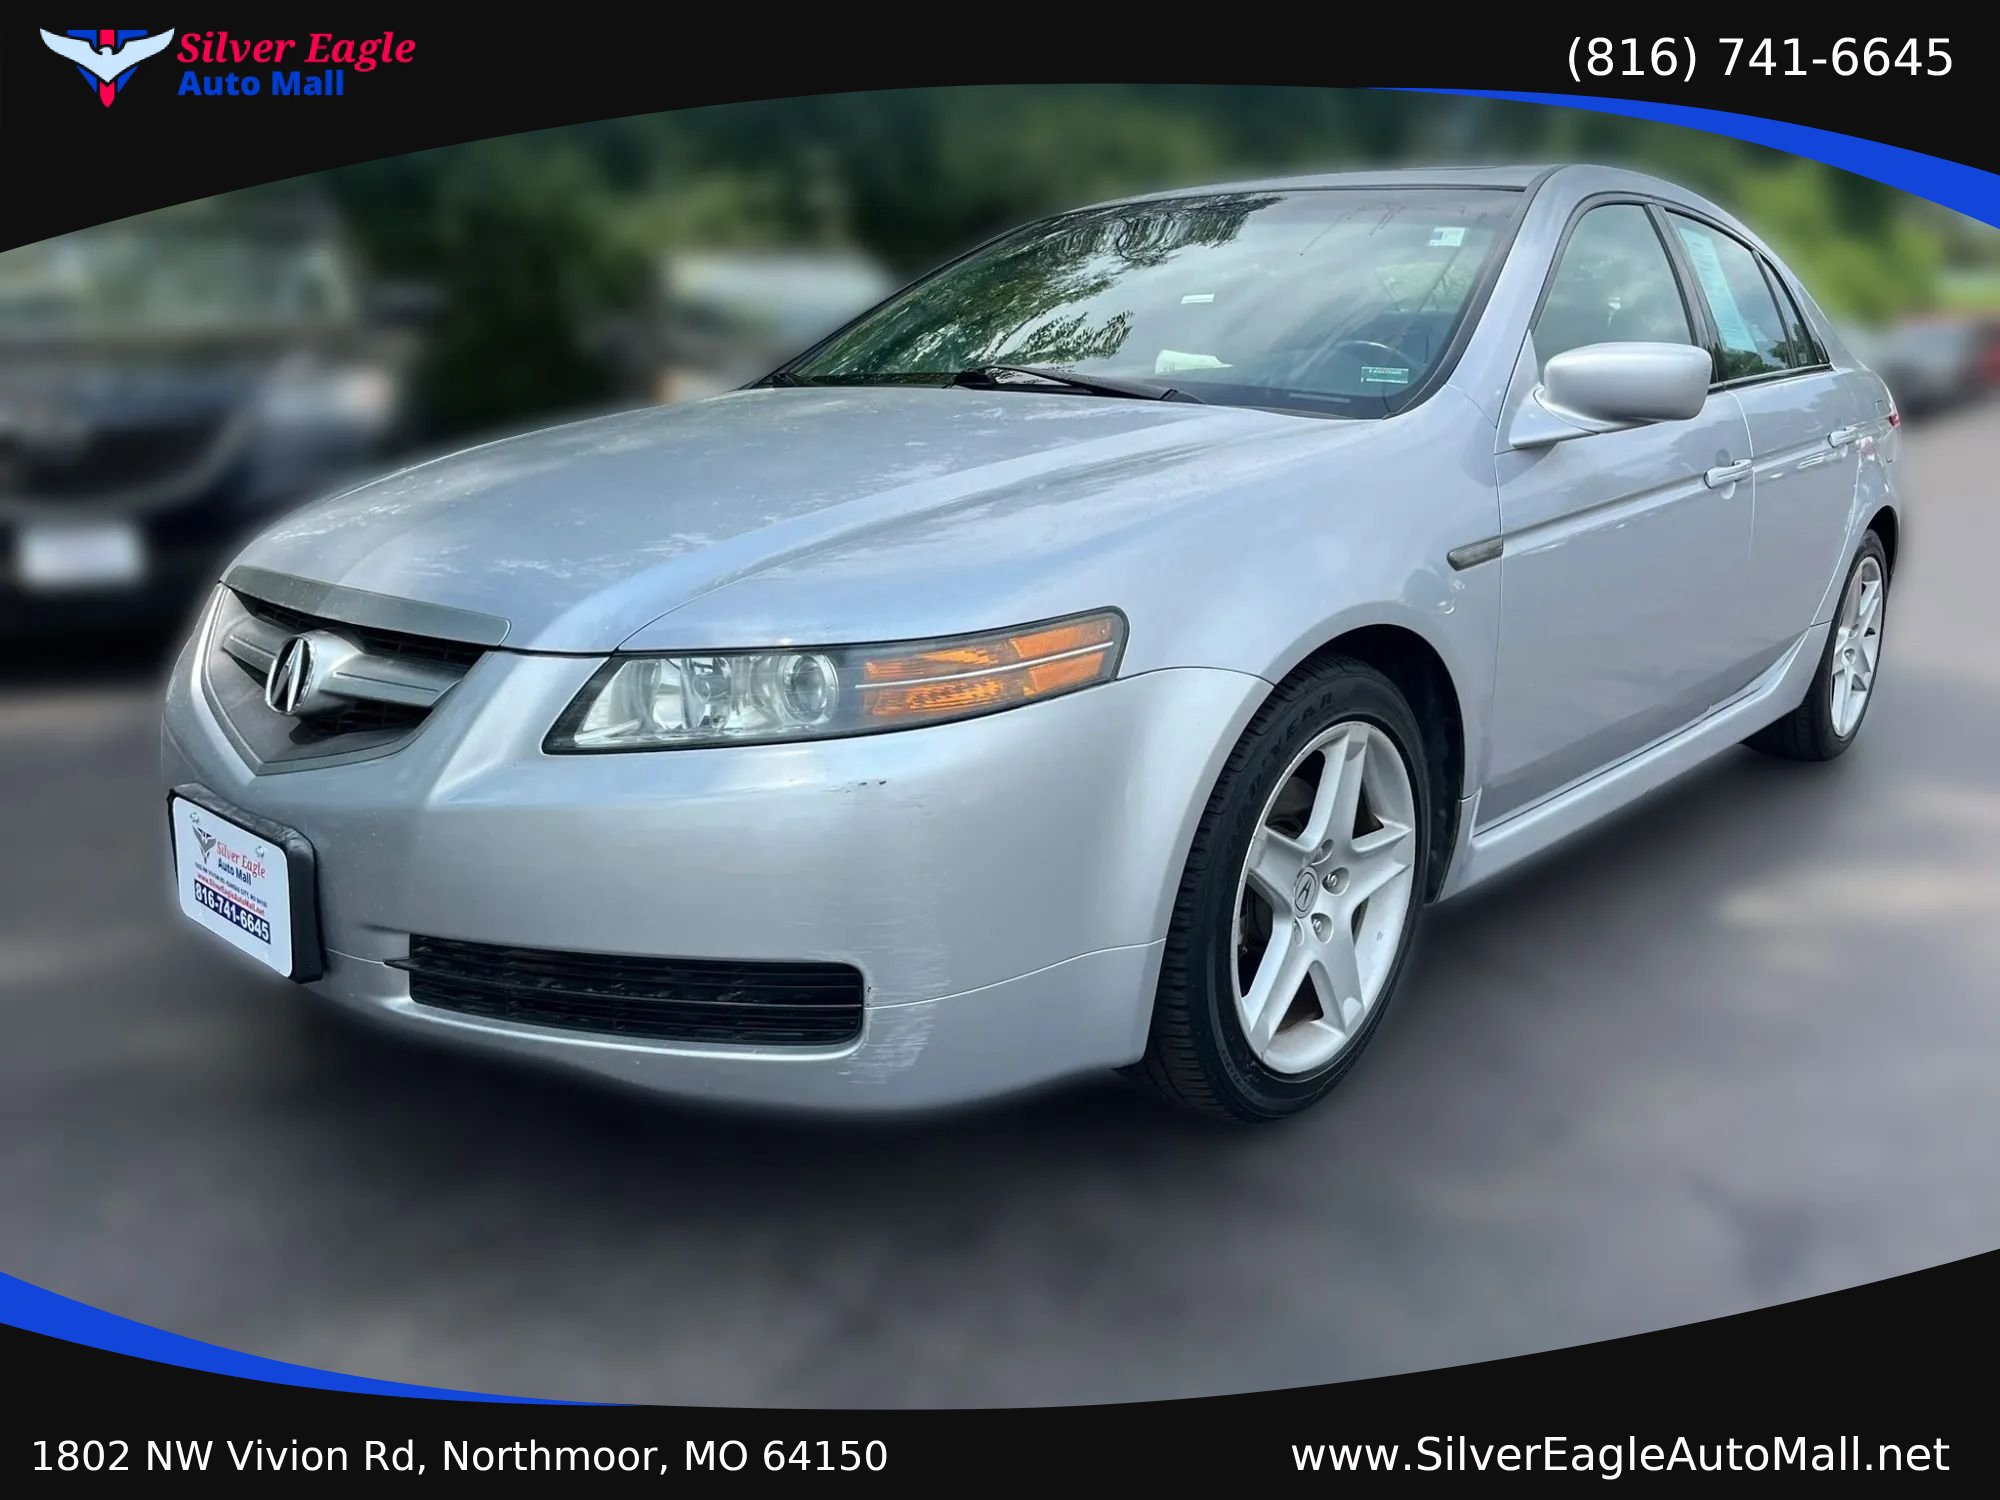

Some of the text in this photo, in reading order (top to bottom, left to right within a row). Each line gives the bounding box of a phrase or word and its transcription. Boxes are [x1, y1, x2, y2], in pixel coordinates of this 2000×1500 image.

[216, 841, 266, 879] Silver Eagle
[218, 858, 235, 876] Auto
[236, 868, 252, 886] Mall
[195, 882, 269, 941] 816-741-6645
